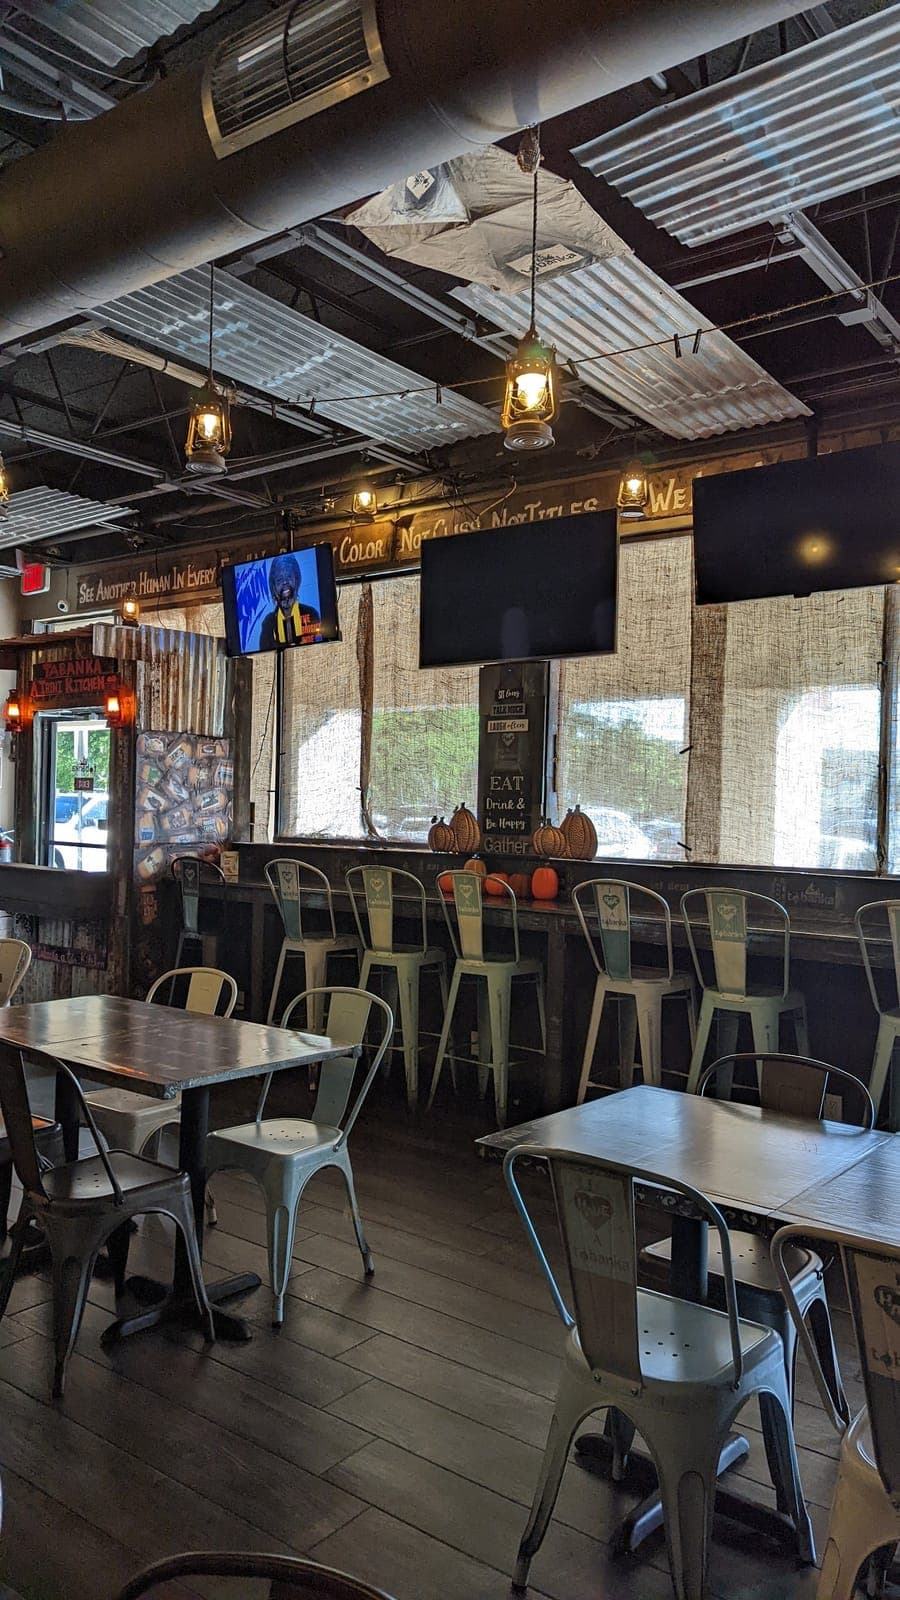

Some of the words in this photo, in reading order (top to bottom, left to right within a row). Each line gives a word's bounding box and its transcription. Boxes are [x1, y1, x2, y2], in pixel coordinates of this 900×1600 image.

[44, 658, 101, 677] TABANKA
[65, 675, 105, 694] KITCHEN
[490, 776, 524, 790] EAT
[486, 797, 514, 810] Drink
[516, 797, 525, 810] &
[486, 818, 496, 830] Be
[499, 817, 525, 830] Happy
[484, 836, 528, 855] Gather
